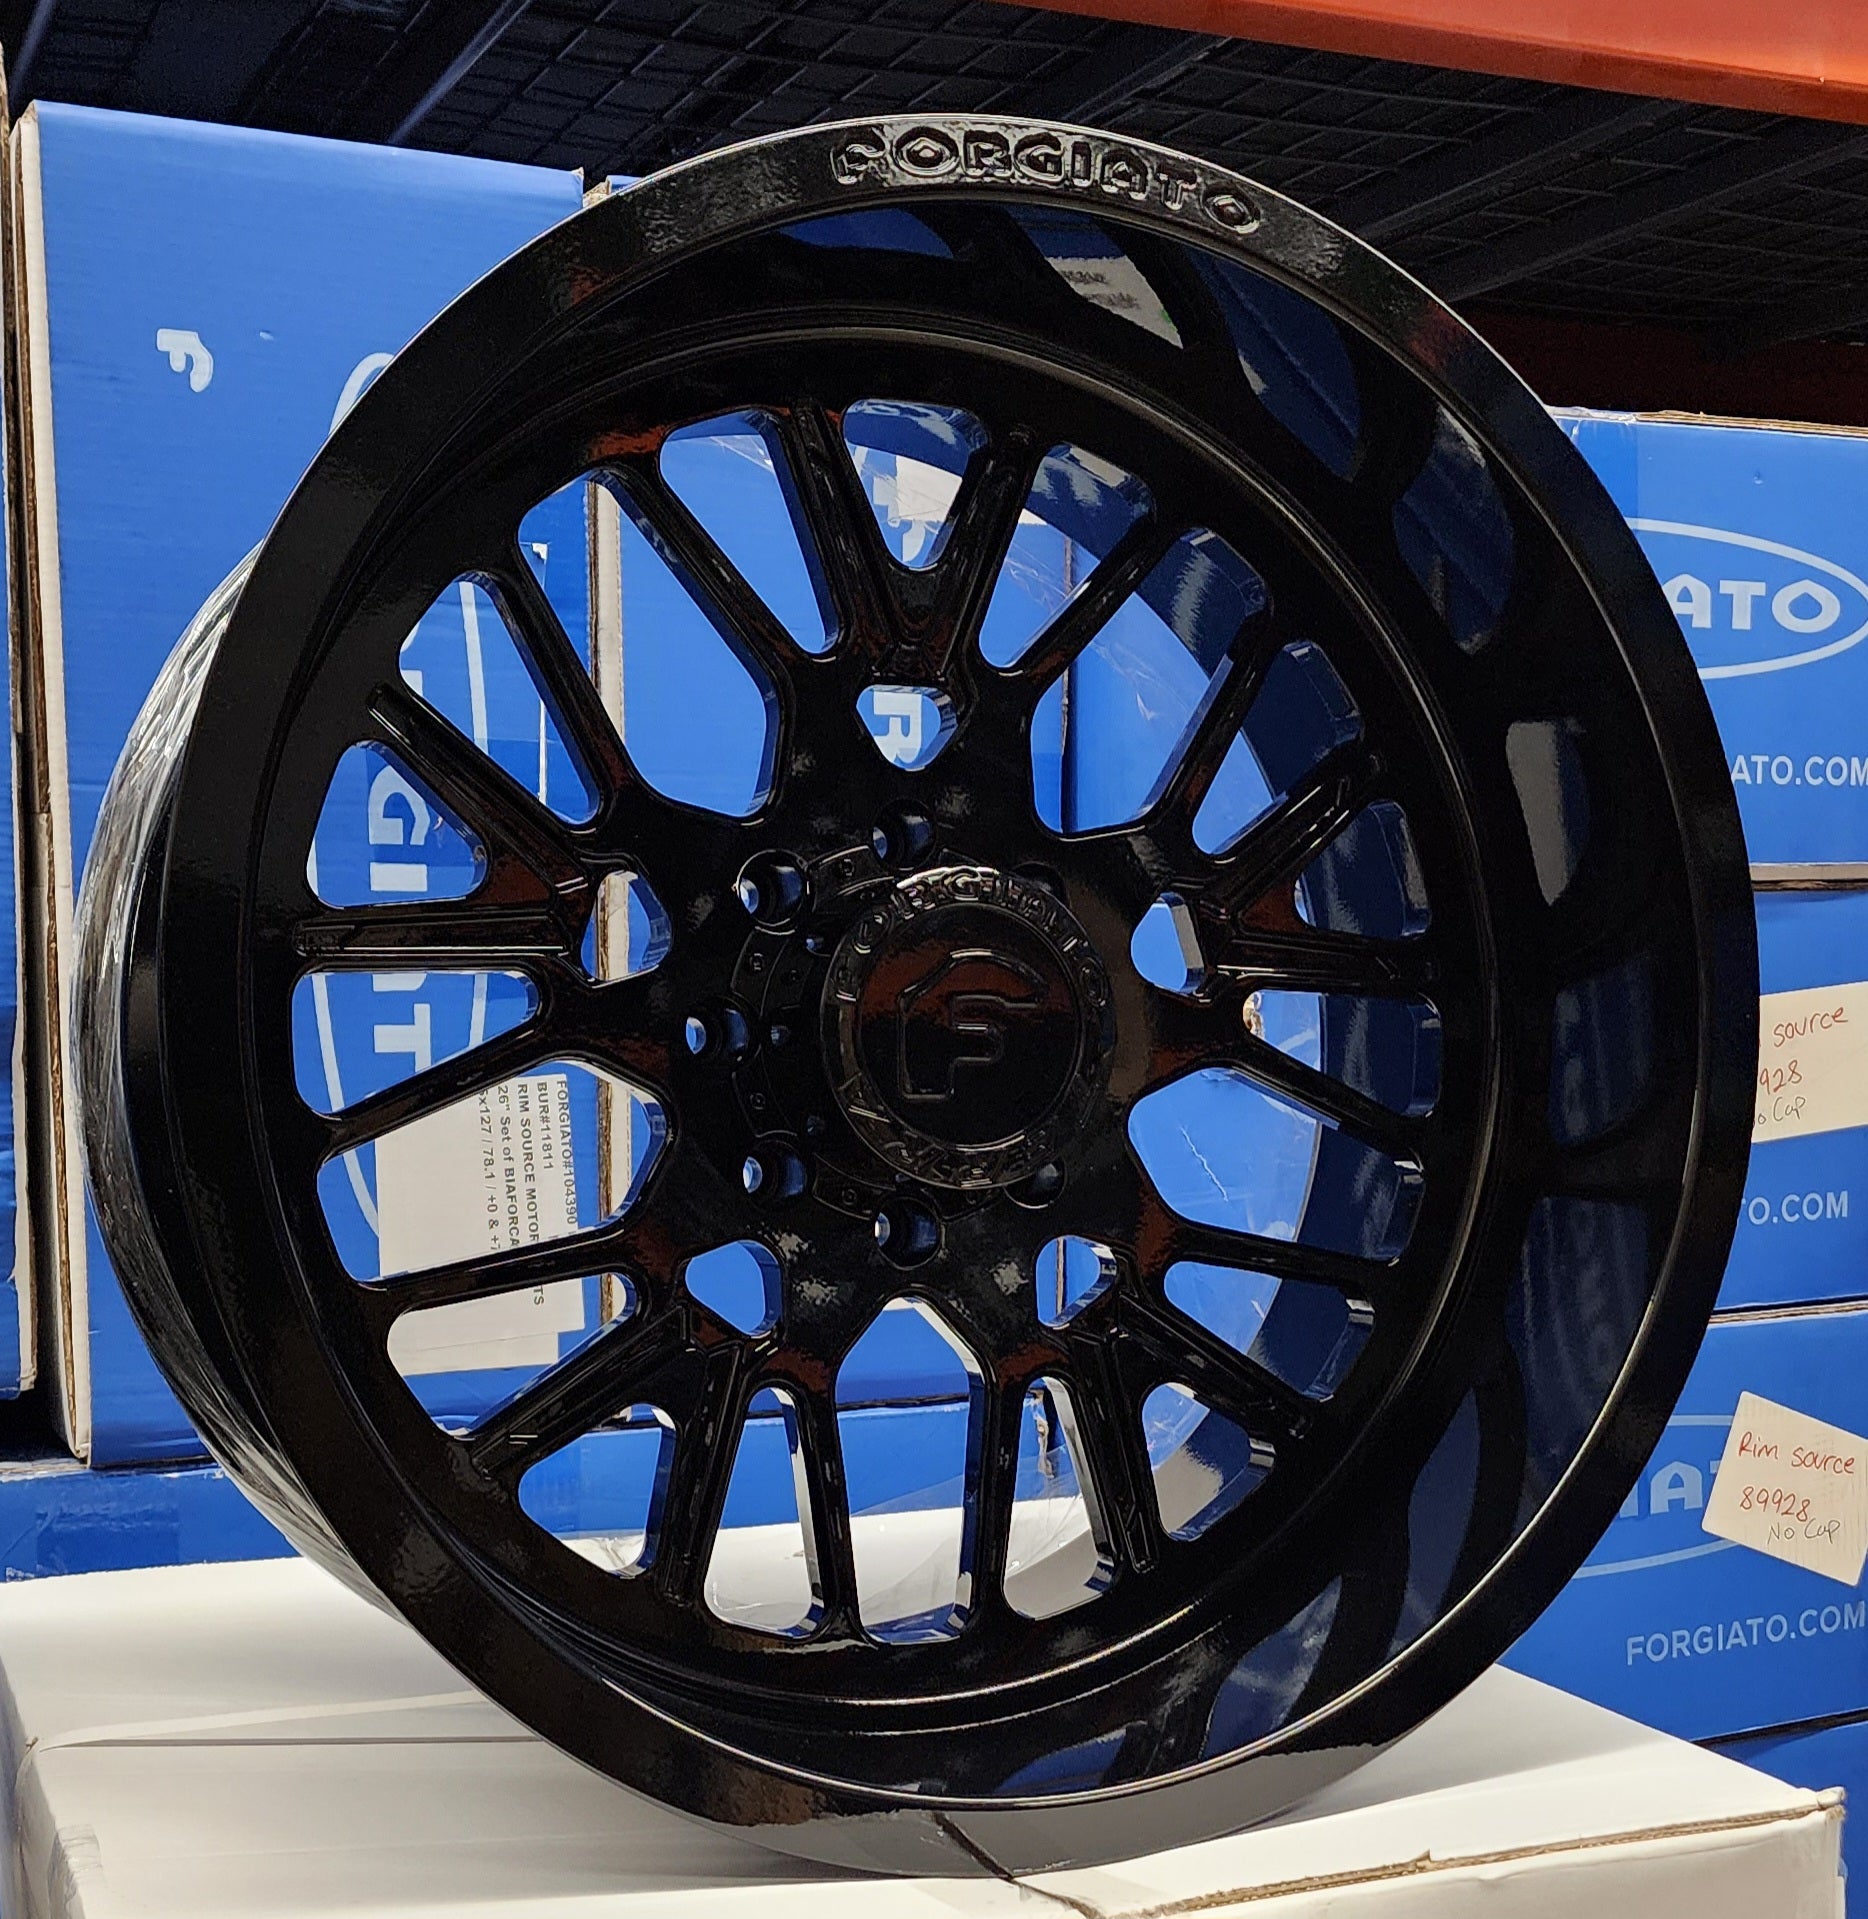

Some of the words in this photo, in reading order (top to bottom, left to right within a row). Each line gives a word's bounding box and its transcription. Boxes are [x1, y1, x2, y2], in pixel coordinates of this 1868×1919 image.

[830, 126, 1261, 234] FORGIATO
[518, 1083, 530, 1113] RIM
[500, 1116, 513, 1142] Set
[536, 1081, 554, 1169] BUR#11811
[483, 1147, 496, 1180] 78.1
[503, 1148, 514, 1163] of
[520, 1119, 536, 1182] SOURCE
[557, 1079, 578, 1225] FORGIATO#104390
[488, 1219, 500, 1230] &
[1742, 1190, 1848, 1225] O.COM
[1738, 1431, 1779, 1461] Rim
[1740, 1485, 1811, 1522] 89928
[1627, 1600, 1865, 1666] FORGIATO.COM
